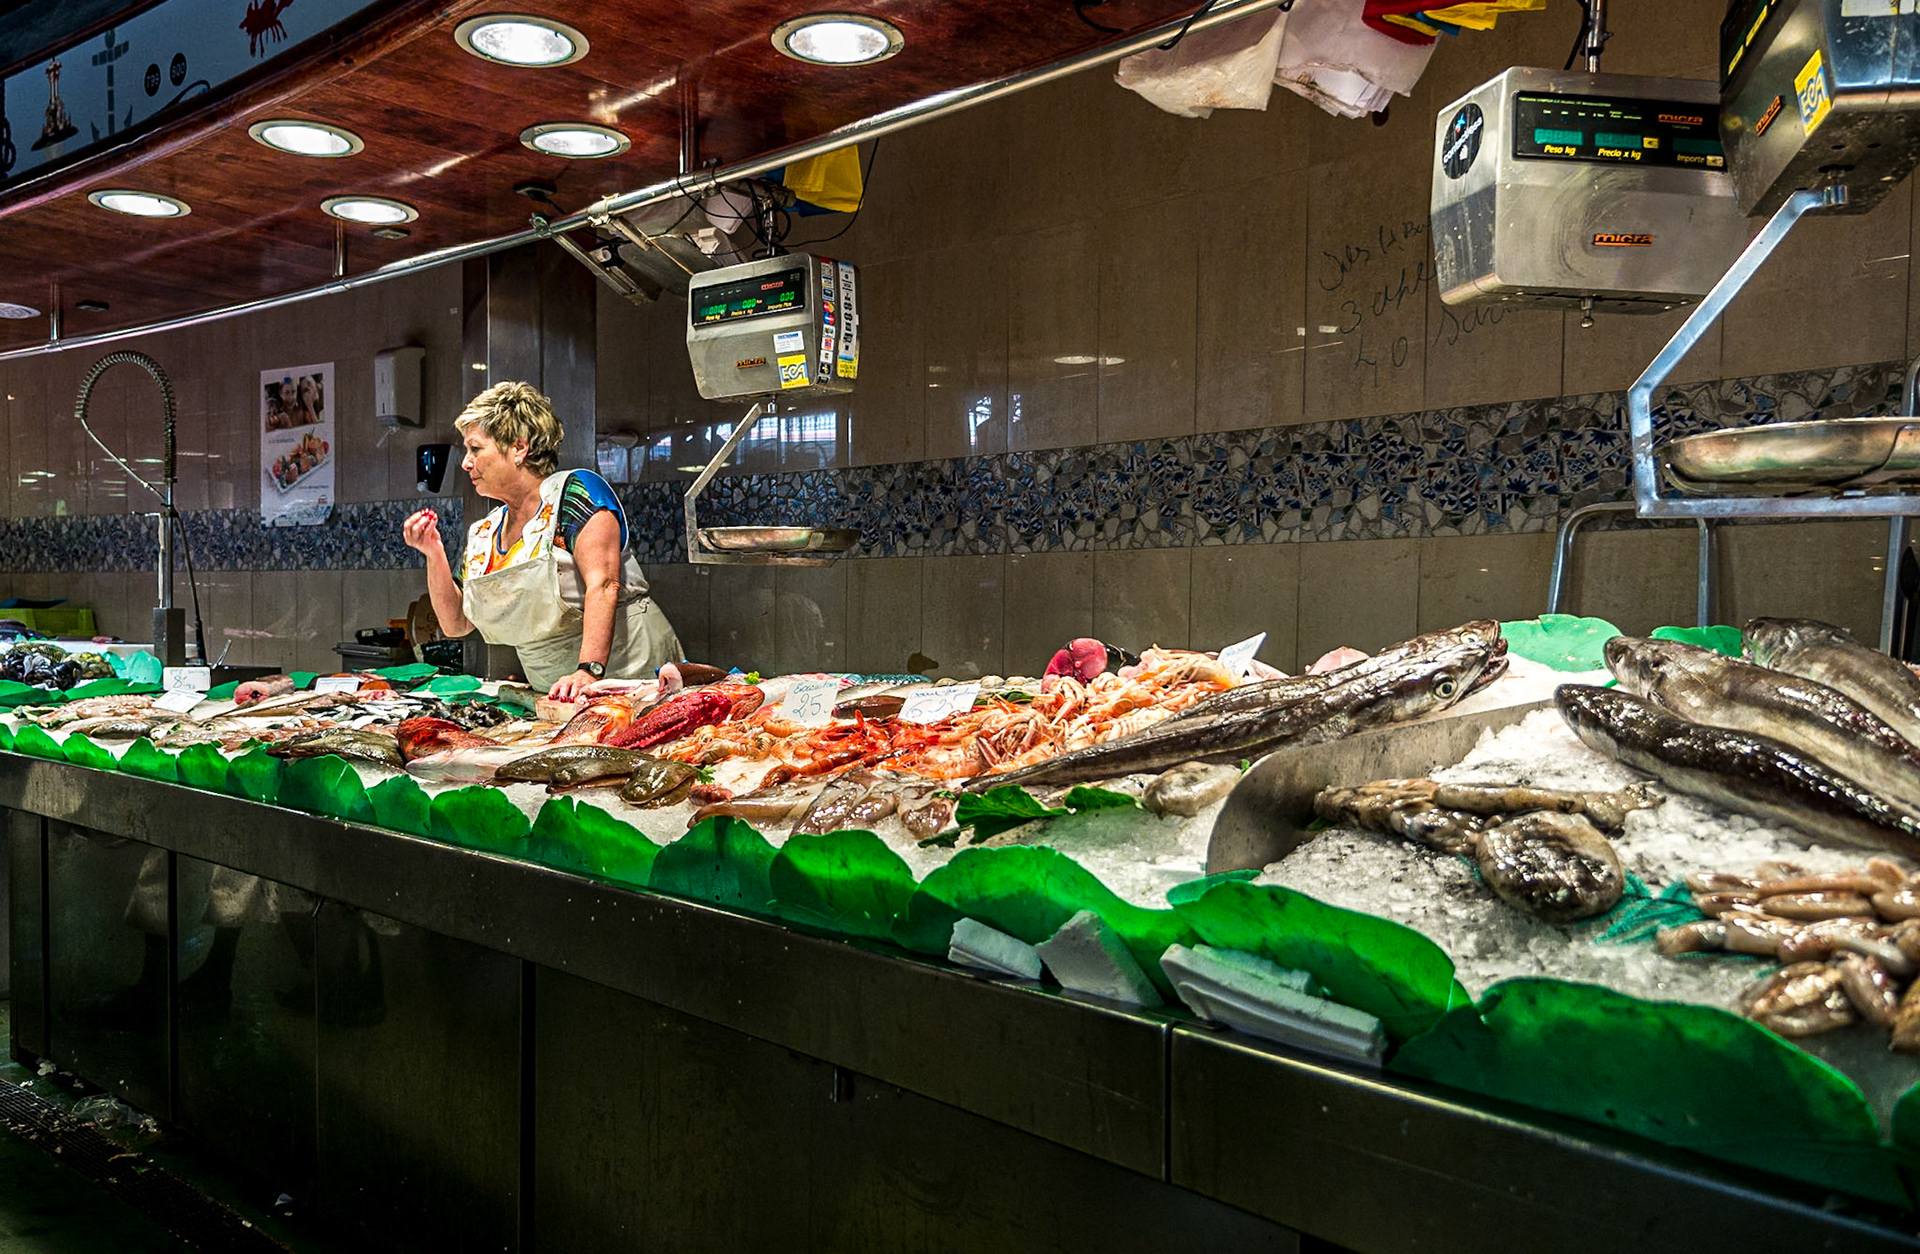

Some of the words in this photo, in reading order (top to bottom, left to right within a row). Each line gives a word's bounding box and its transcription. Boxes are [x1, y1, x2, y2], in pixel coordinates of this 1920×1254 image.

[1800, 72, 1827, 118] ECA
[1658, 113, 1704, 124] micra
[1755, 95, 1782, 136] micra
[1443, 116, 1483, 163] contactless
[1543, 144, 1563, 154] Peso
[1565, 145, 1577, 156] kg
[1597, 147, 1622, 158] Precio
[1631, 150, 1642, 160] kg
[1676, 154, 1705, 165] Importe
[1594, 233, 1653, 245] micra
[781, 362, 807, 380] ECA
